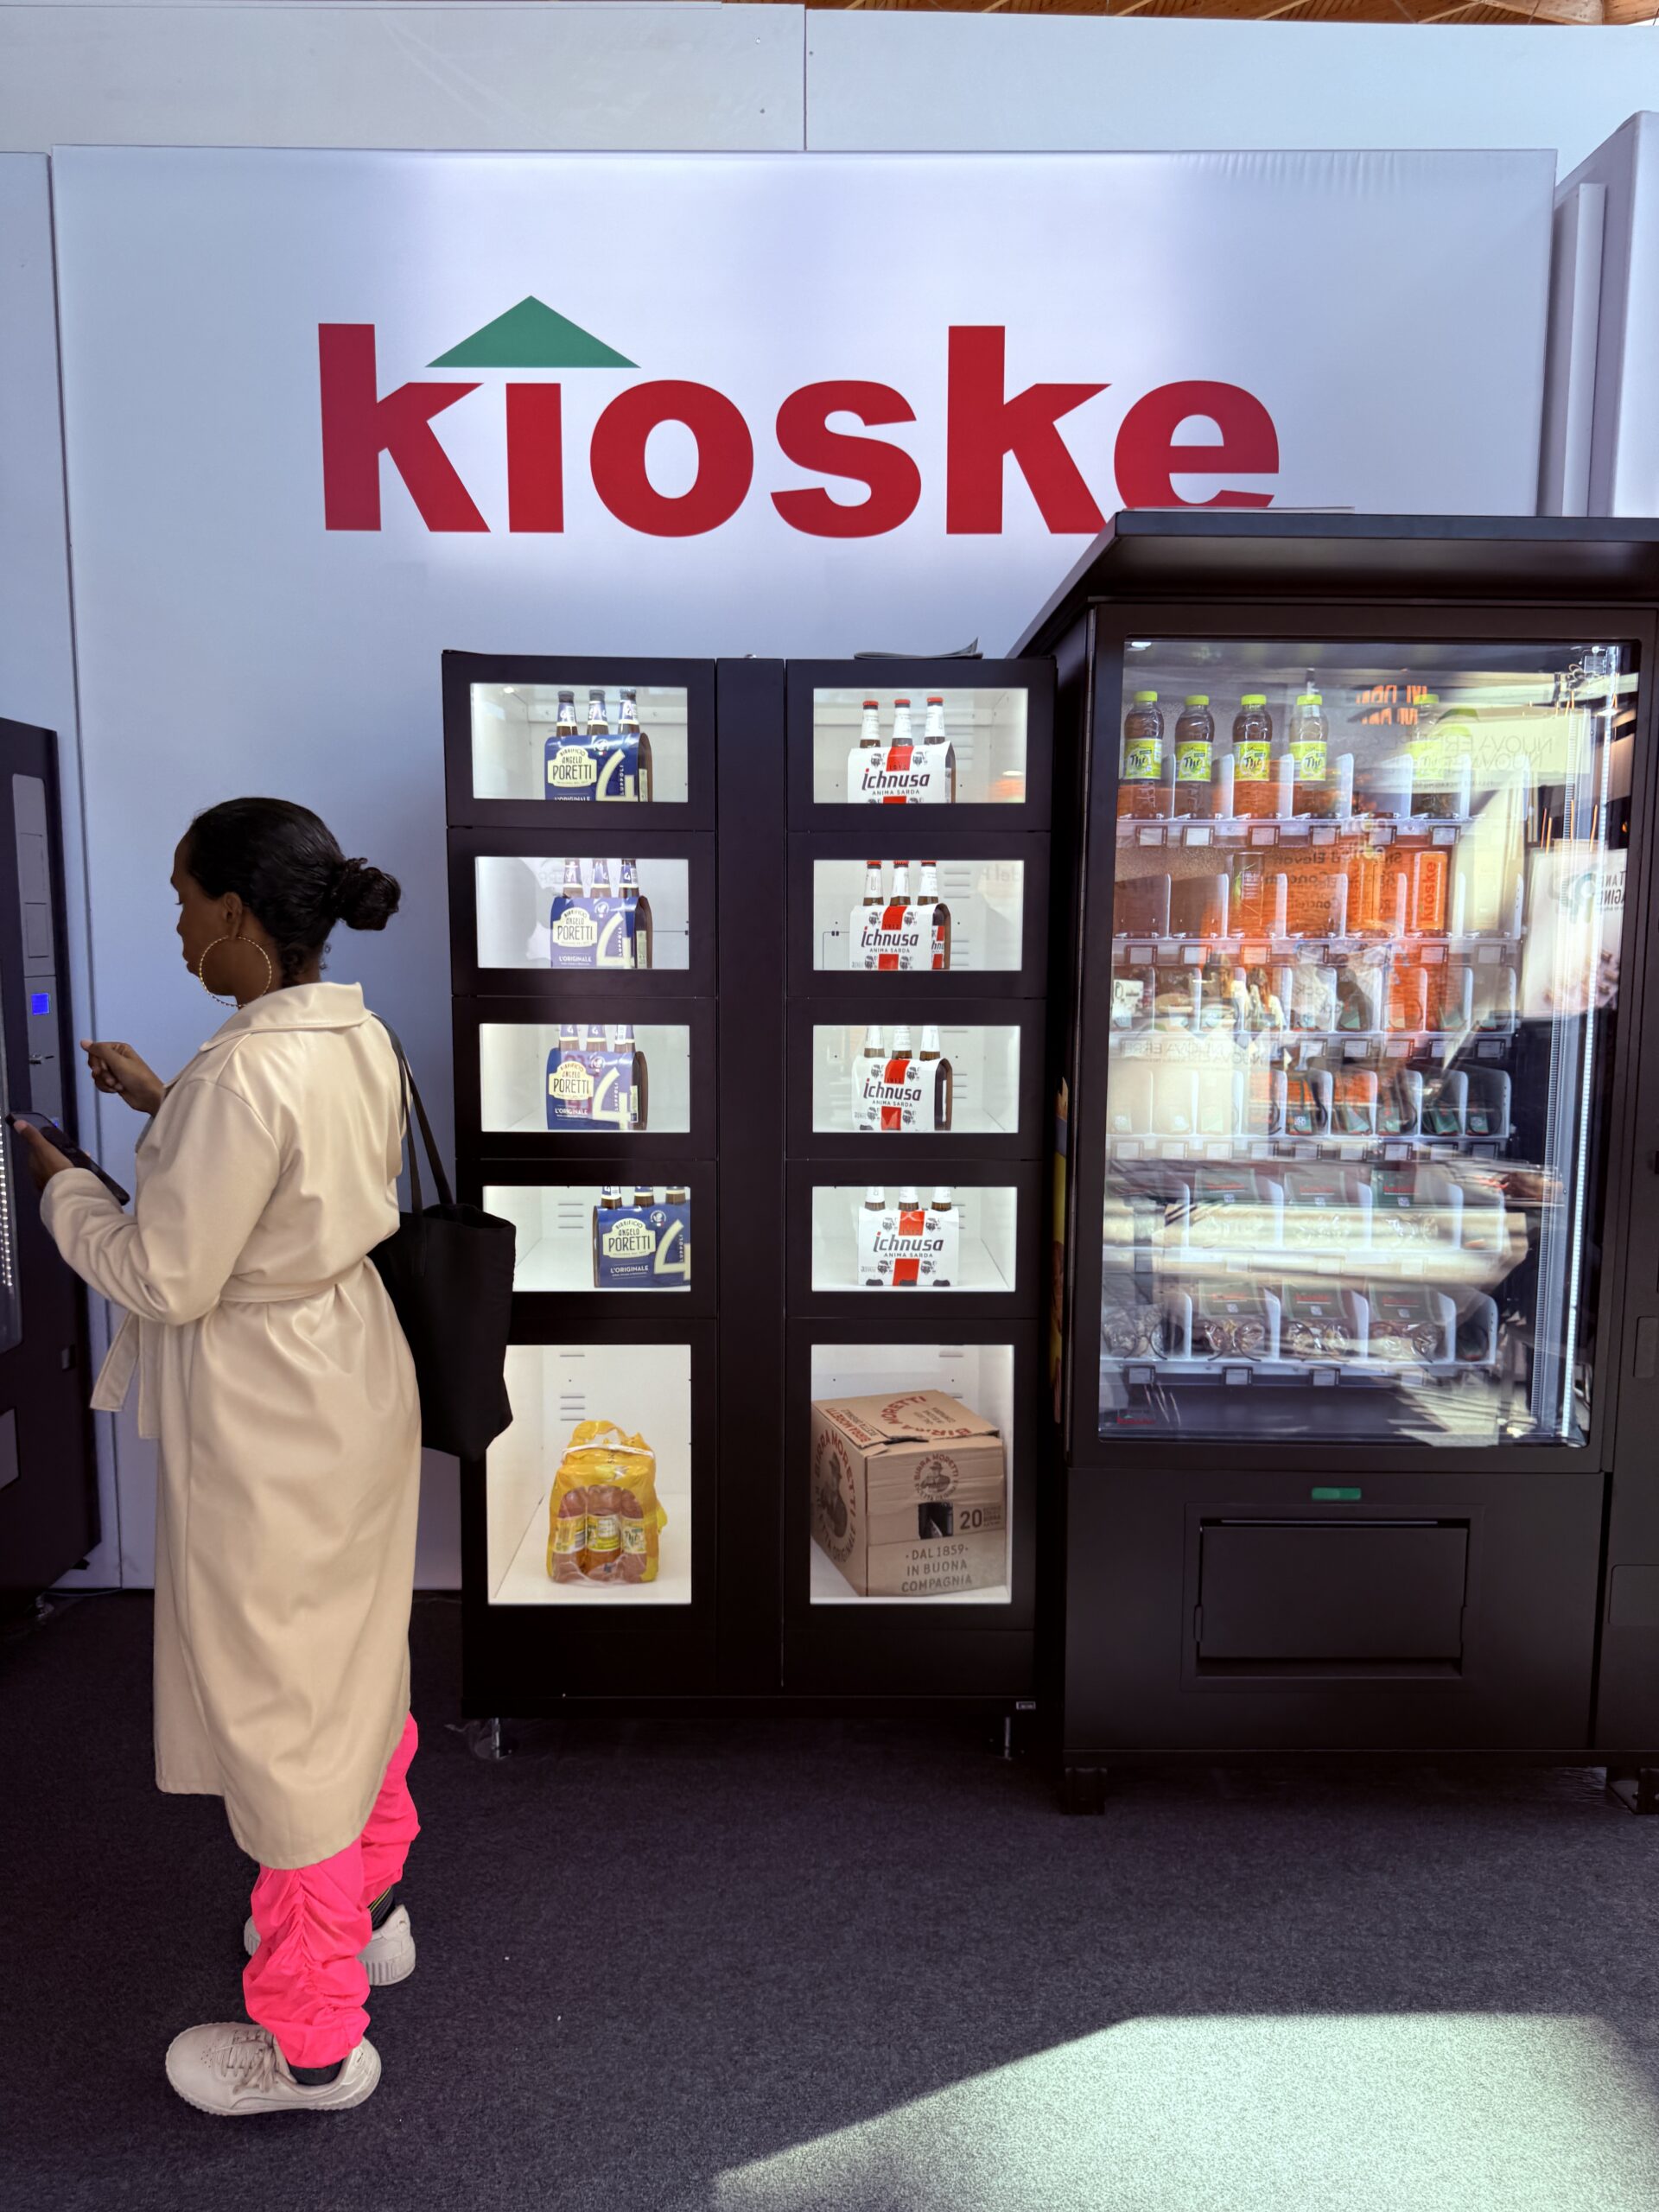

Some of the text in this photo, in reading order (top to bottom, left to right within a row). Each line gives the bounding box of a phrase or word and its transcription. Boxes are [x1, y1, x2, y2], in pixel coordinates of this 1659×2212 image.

[318, 296, 1279, 537] kioske
[552, 764, 592, 780] PORETTI
[861, 768, 931, 791] ichnusa
[556, 925, 593, 940] PORETTI
[861, 925, 919, 948] ichnusa
[553, 1078, 589, 1094] PORETTI
[863, 1078, 922, 1101] ichnusa
[618, 1228, 639, 1236] ANGELO
[608, 1236, 650, 1252] PORETTI
[873, 1231, 944, 1253] ichnusa
[610, 1265, 649, 1274] L'ORIGINALE
[960, 1509, 982, 1530] 20
[912, 1549, 933, 1560] DAL
[907, 1560, 968, 1576] IN BUONA
[901, 1574, 973, 1592] COMPAGNIA
